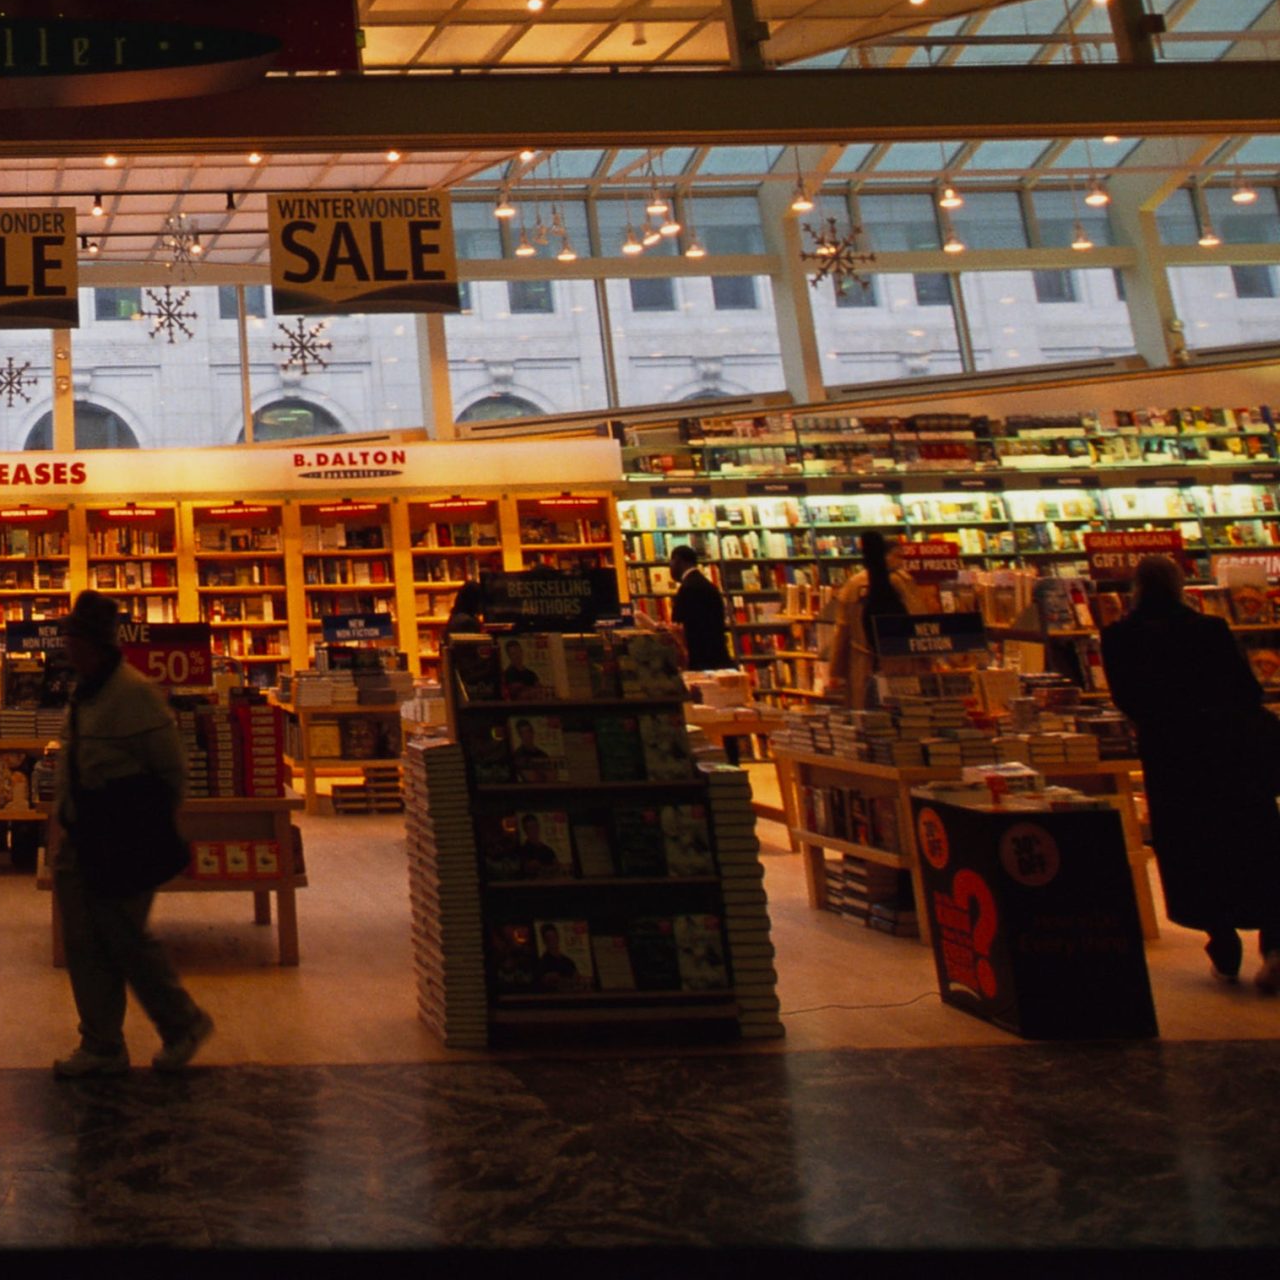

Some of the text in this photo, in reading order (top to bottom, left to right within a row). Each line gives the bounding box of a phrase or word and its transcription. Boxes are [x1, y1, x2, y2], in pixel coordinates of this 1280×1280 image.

[282, 221, 445, 283] SALE
[294, 450, 406, 467] B. DALTON
[1092, 553, 1125, 568] GIFT
[507, 579, 592, 598] BESTSELLING
[521, 599, 582, 615] AUTHORS
[117, 625, 150, 643] AVE
[913, 622, 940, 635] NEW
[908, 636, 953, 652] FICTION
